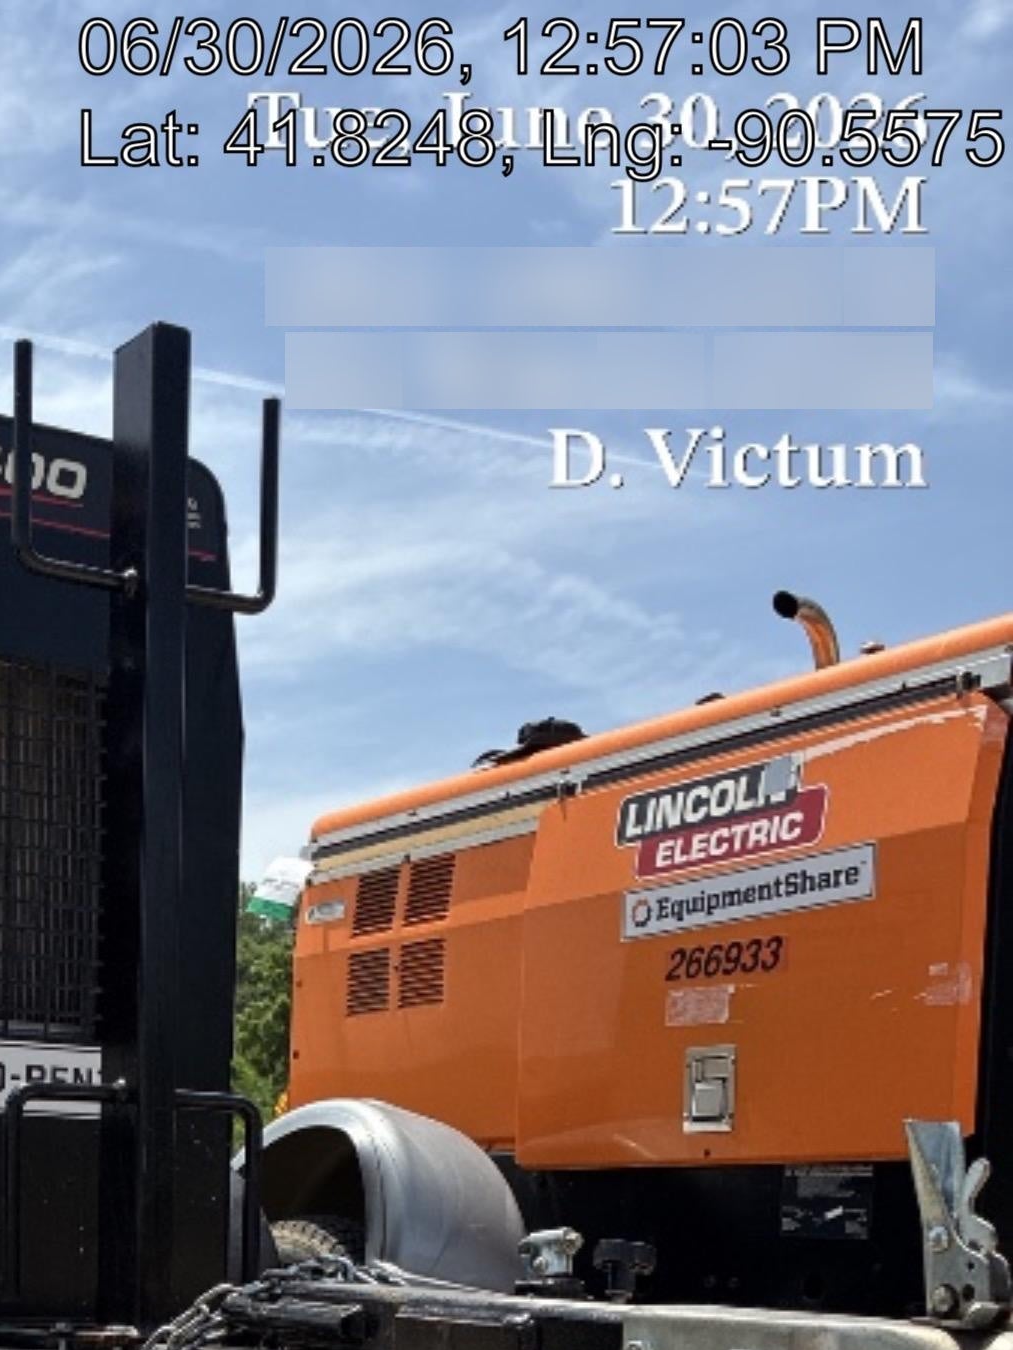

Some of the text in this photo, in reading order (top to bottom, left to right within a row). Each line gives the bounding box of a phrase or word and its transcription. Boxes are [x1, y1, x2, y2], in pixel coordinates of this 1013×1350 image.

[655, 811, 804, 869] ELECTRIC
[656, 864, 859, 922] EquipmentShare
[665, 935, 783, 981] 266933
